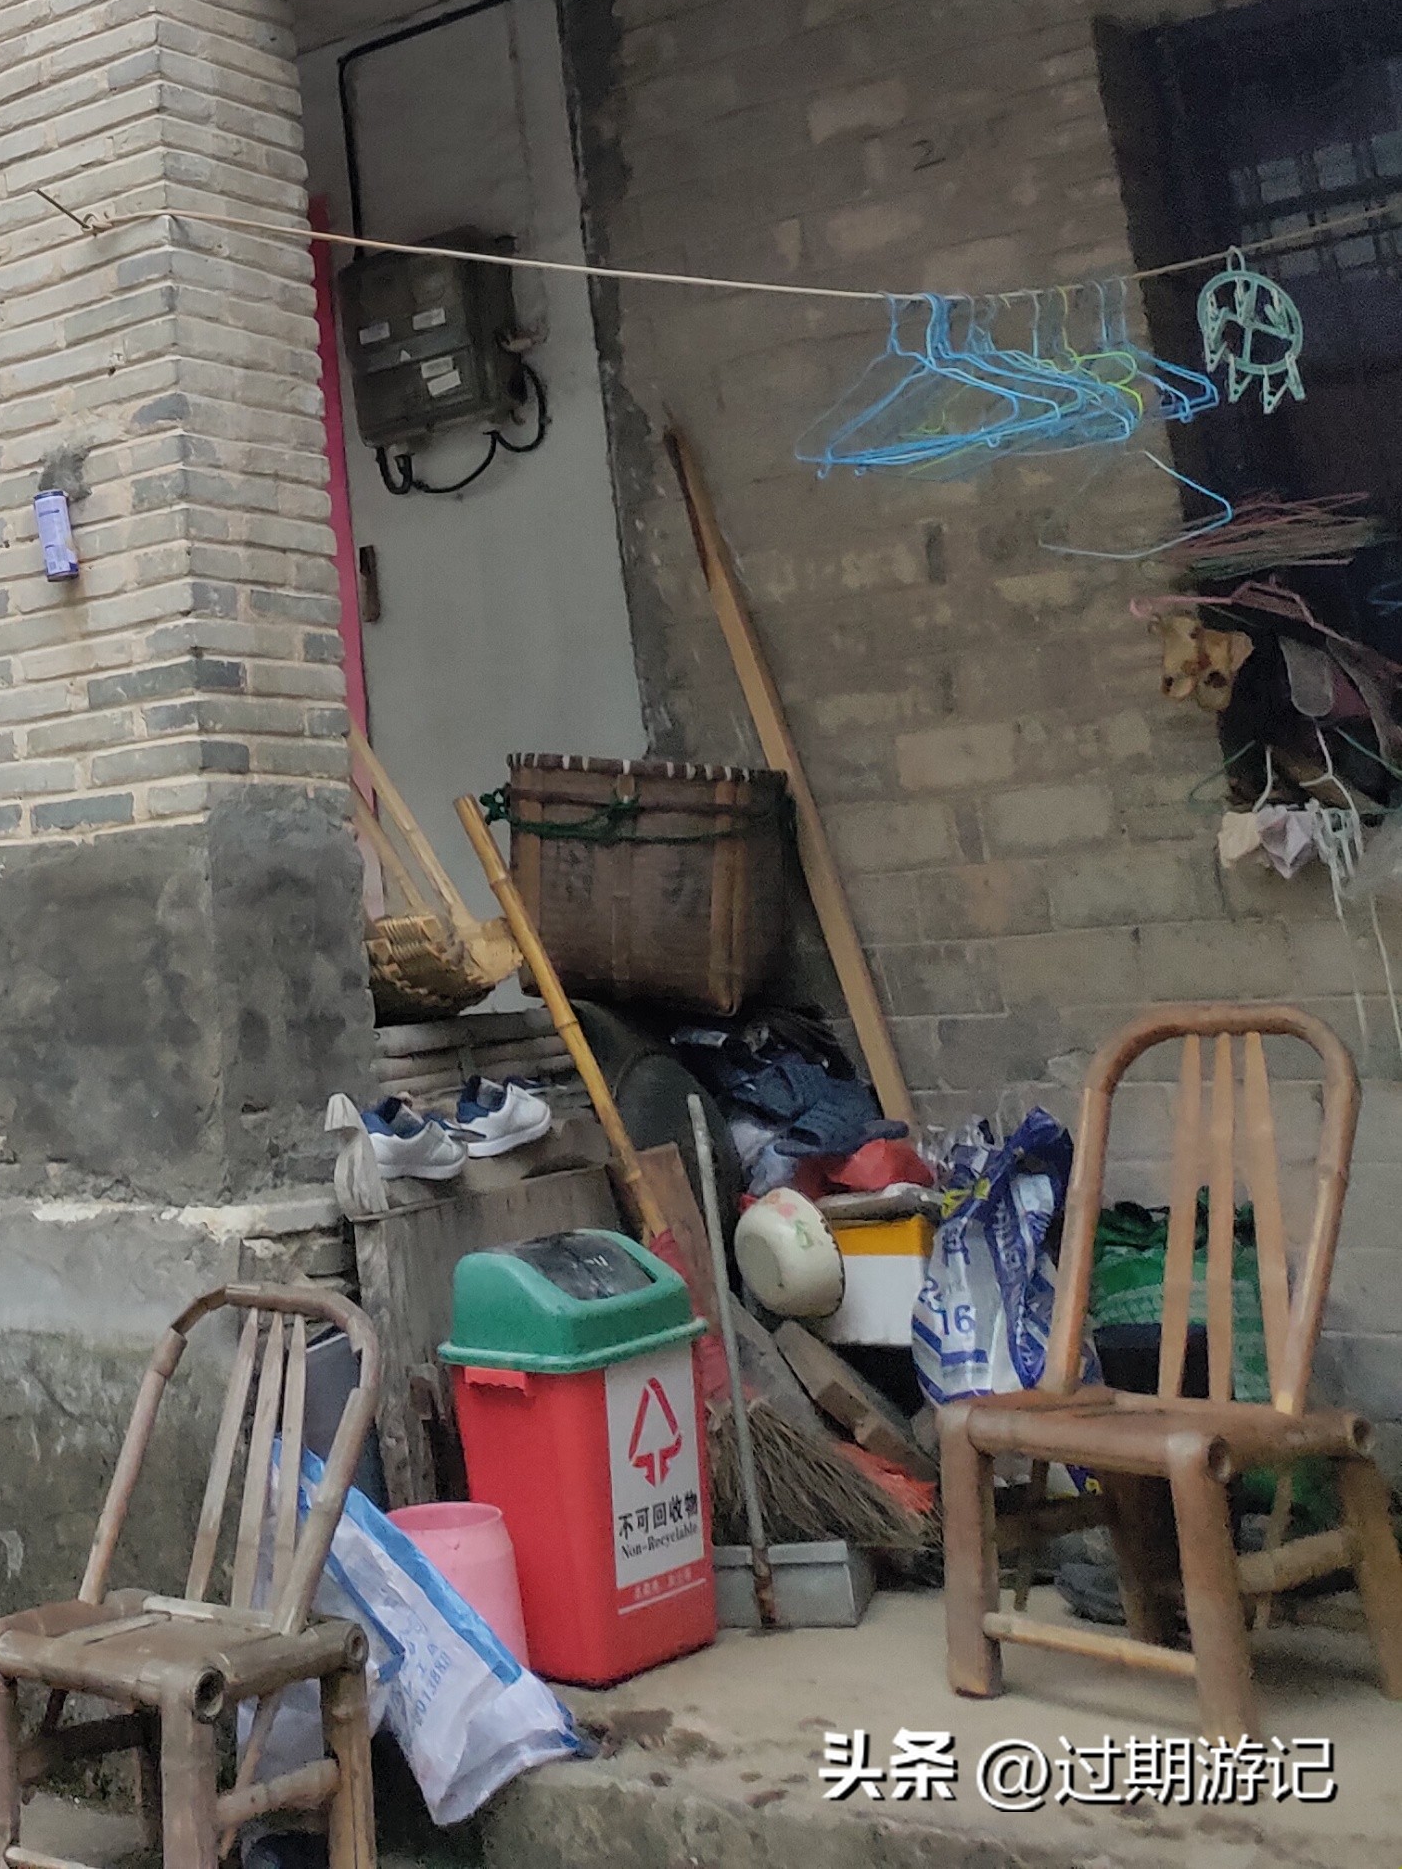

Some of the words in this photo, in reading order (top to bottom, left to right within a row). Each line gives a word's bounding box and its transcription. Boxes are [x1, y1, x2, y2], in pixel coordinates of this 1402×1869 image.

[618, 1488, 698, 1541] 不可回收物
